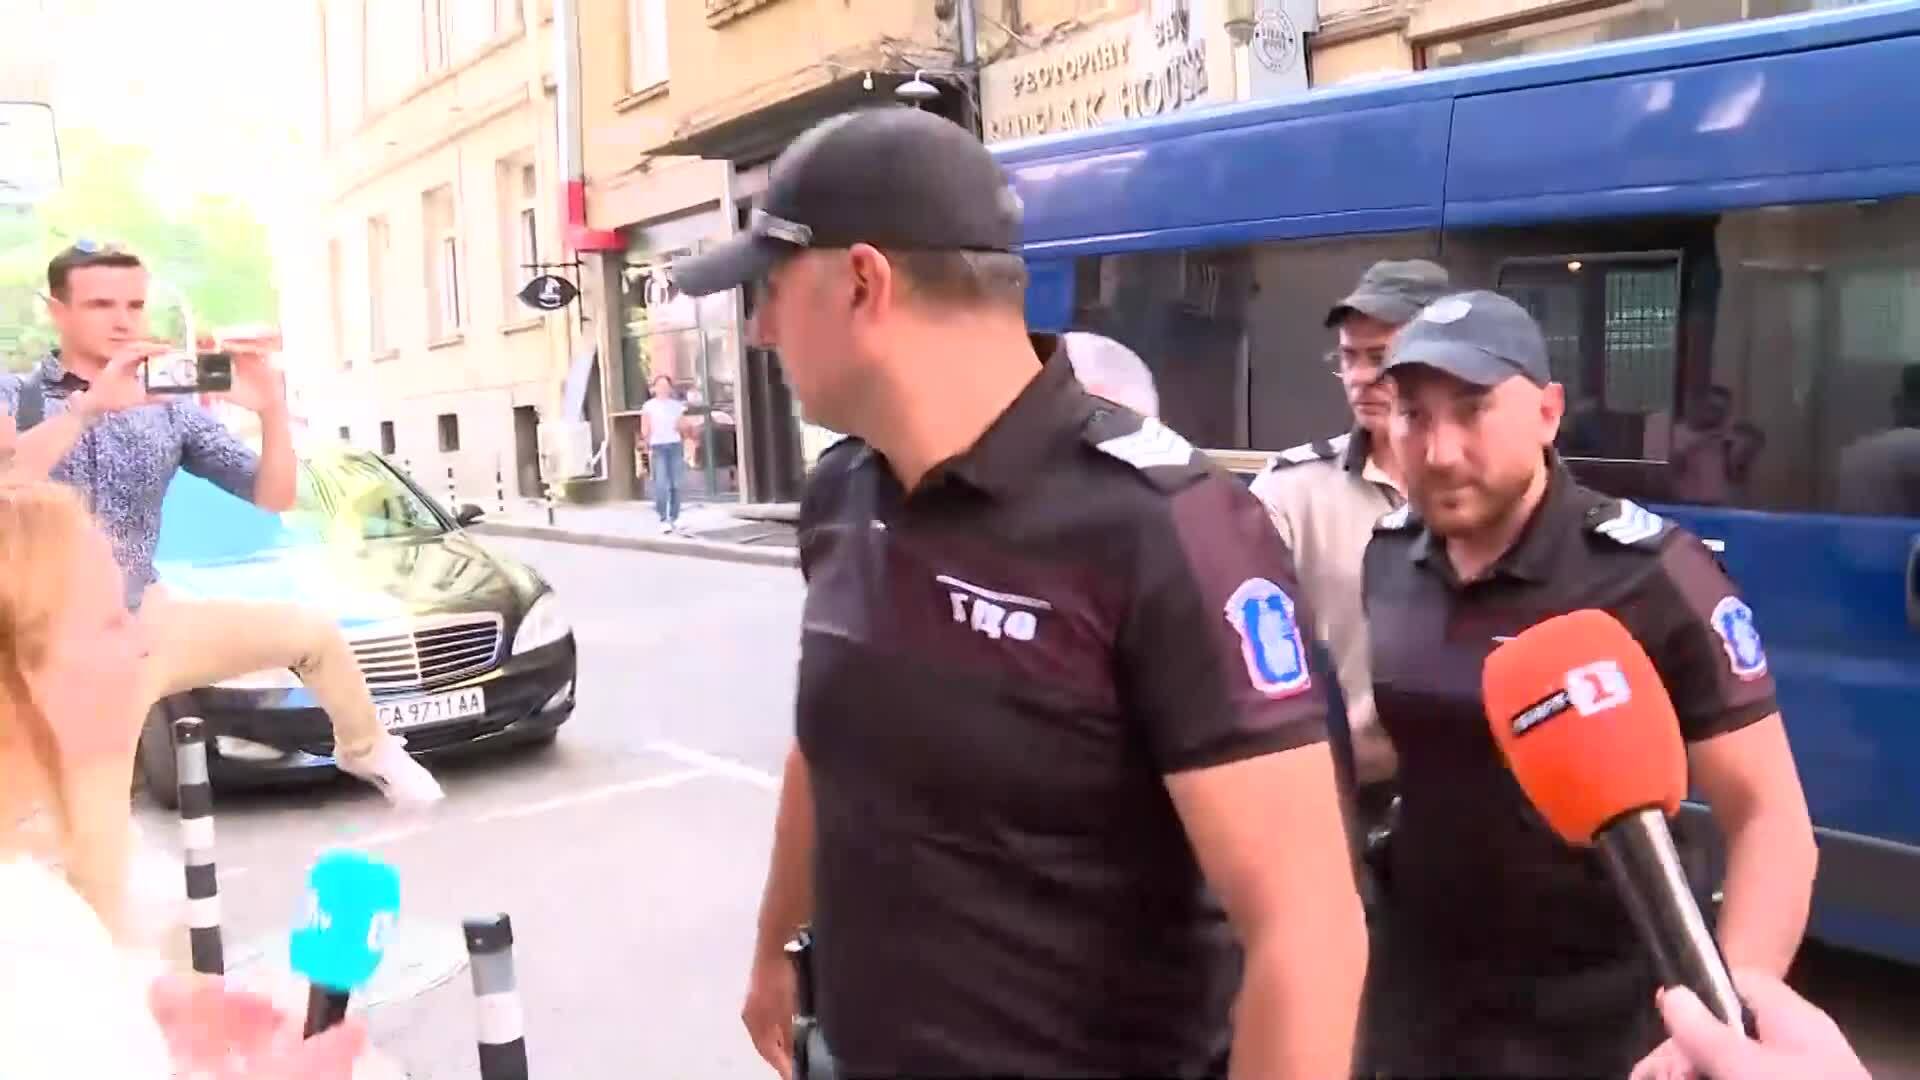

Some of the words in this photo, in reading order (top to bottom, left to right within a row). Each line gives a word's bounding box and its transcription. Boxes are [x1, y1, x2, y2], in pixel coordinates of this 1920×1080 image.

[1118, 39, 1209, 120] HOUSE
[1584, 672, 1615, 705] 1
[409, 696, 452, 722] 9711
[459, 692, 480, 714] AA
